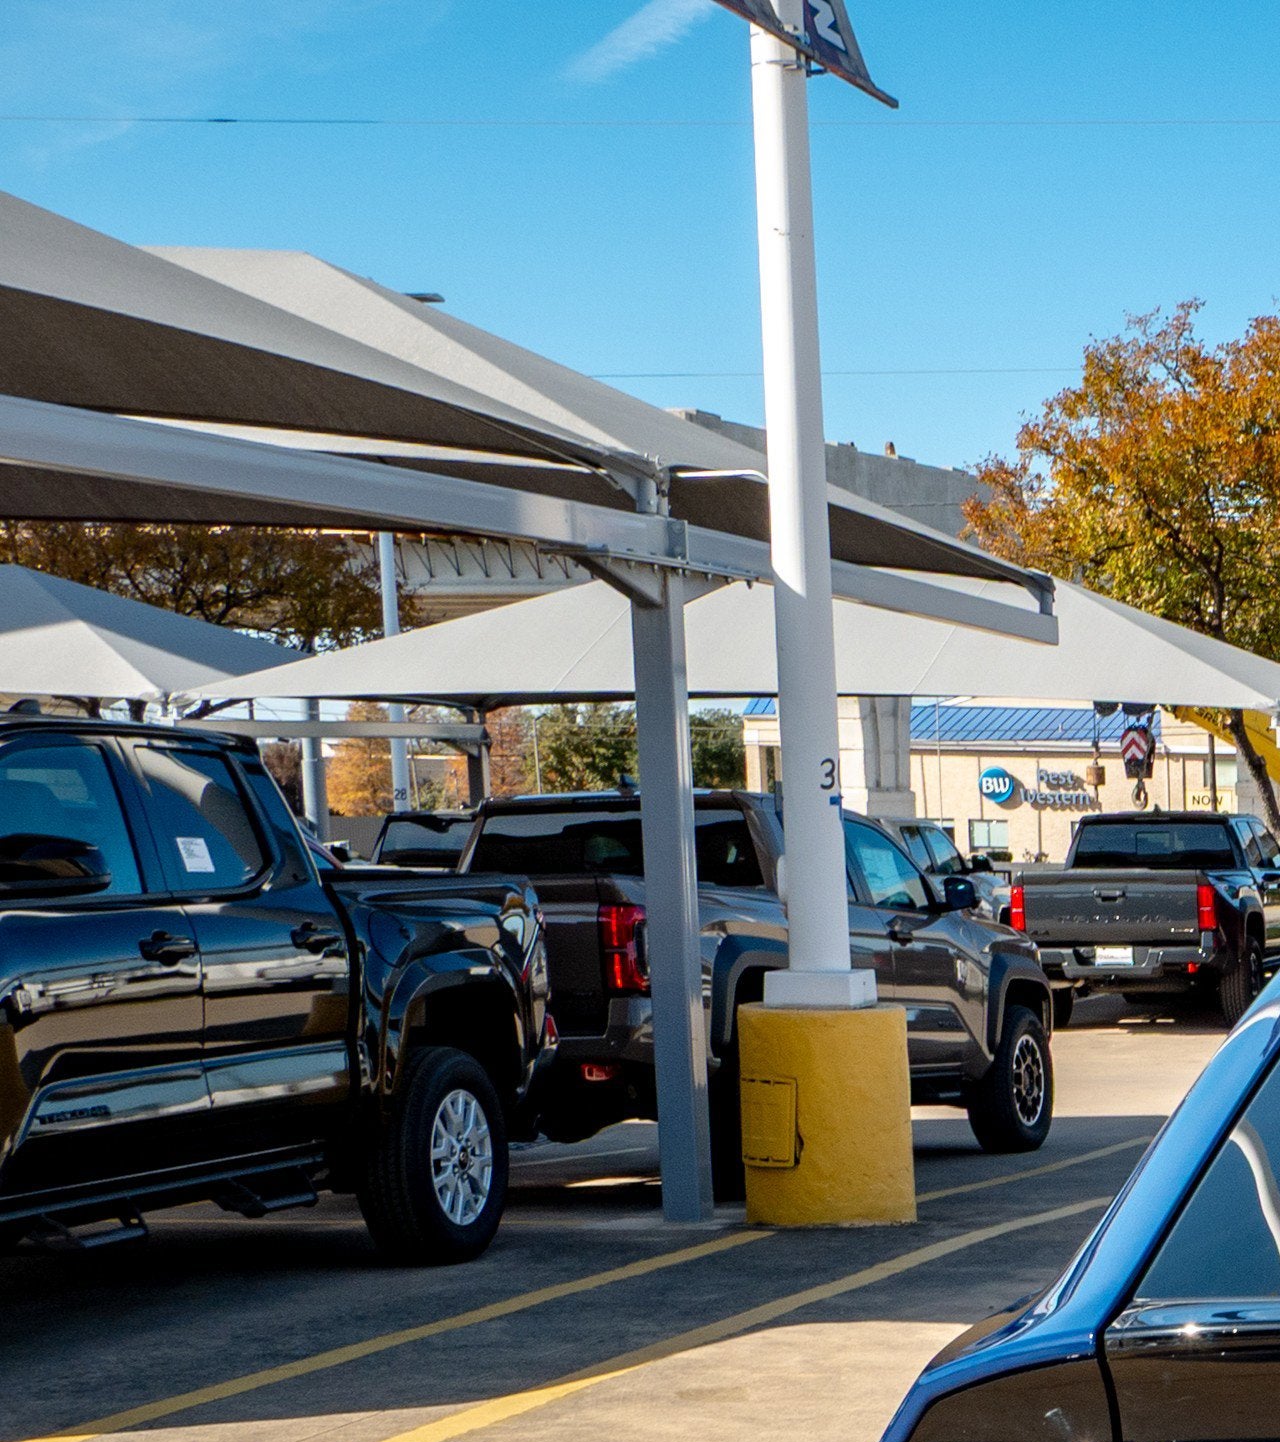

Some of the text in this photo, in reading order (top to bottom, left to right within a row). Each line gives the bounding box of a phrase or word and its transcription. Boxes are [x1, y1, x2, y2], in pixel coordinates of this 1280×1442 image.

[820, 757, 840, 790] 3
[1037, 769, 1074, 785] Best
[981, 777, 1010, 793] BW
[394, 788, 407, 801] 28
[1020, 788, 1091, 805] Western
